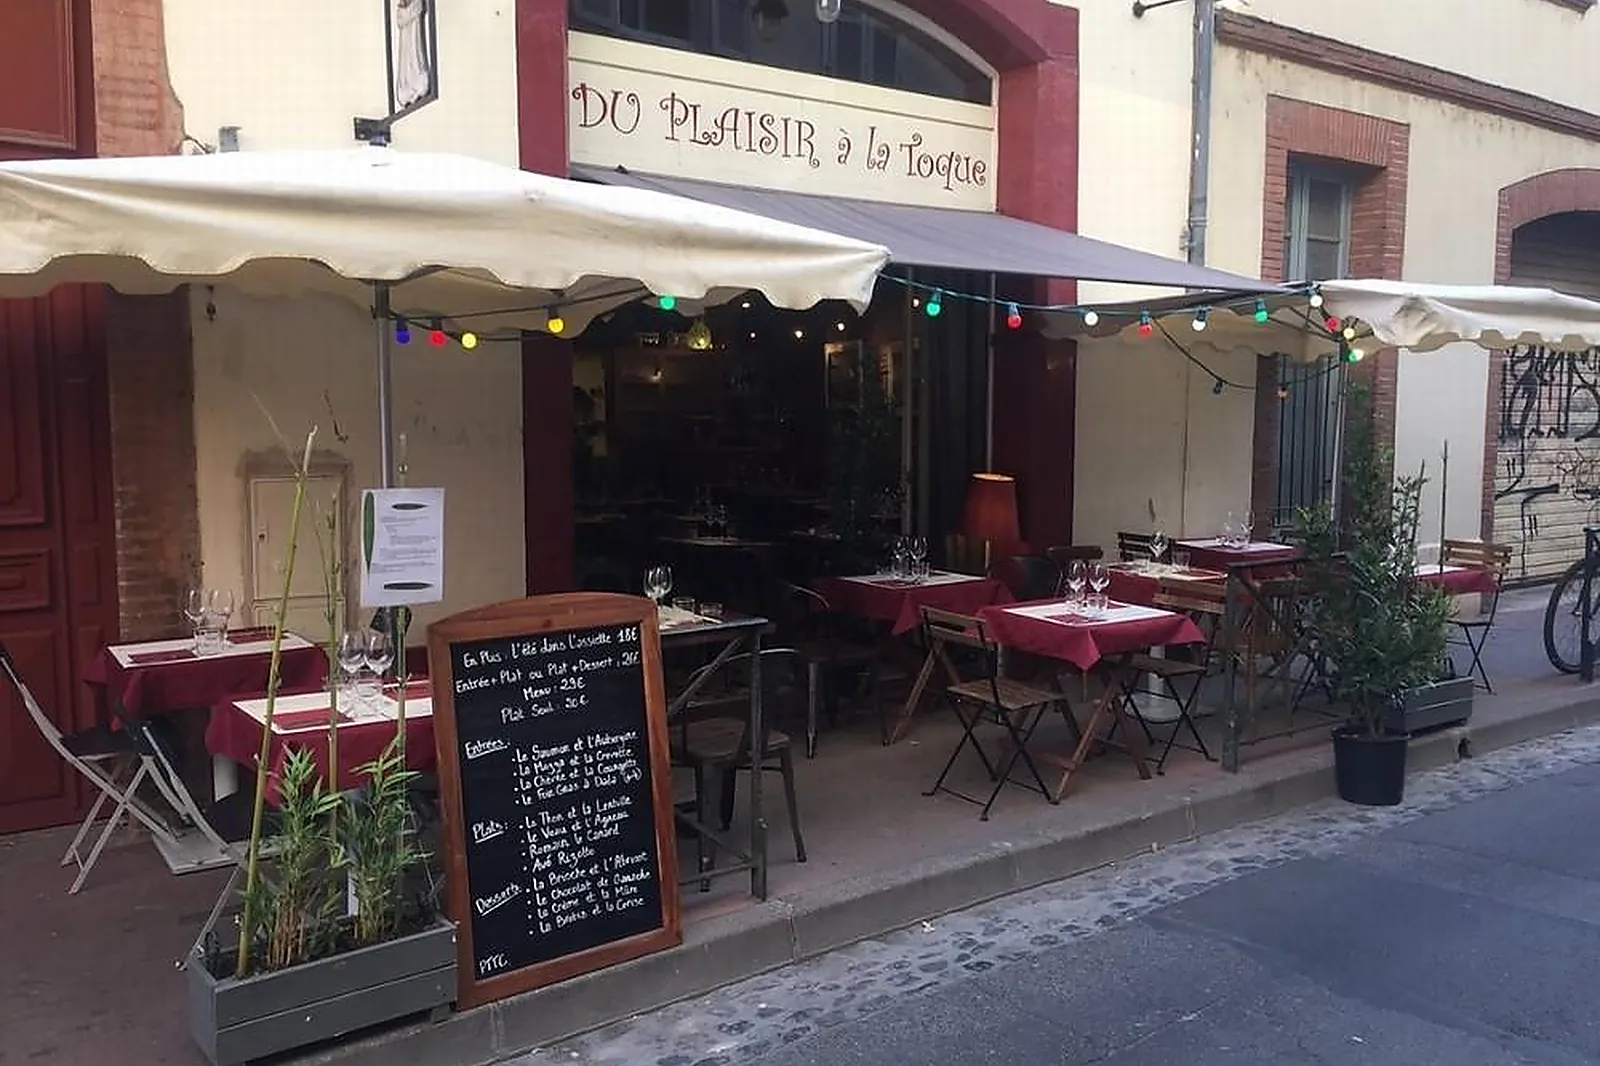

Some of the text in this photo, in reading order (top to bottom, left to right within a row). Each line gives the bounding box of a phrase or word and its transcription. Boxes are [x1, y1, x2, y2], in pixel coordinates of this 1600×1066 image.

[572, 82, 987, 191] DU PLAISIR à la Toque
[540, 637, 566, 652] dans
[500, 668, 523, 684] Plat
[529, 670, 543, 680] ou
[548, 662, 568, 677] Plat
[501, 707, 525, 724] Plat
[516, 749, 529, 763] Le
[574, 737, 584, 751] et
[570, 755, 580, 766] et
[569, 768, 579, 778] et
[568, 807, 578, 819] et
[572, 821, 582, 831] et
[589, 864, 599, 875] et
[536, 893, 548, 906] Le
[551, 880, 591, 899] Chocolat
[586, 893, 597, 904] et
[592, 904, 602, 916] et
